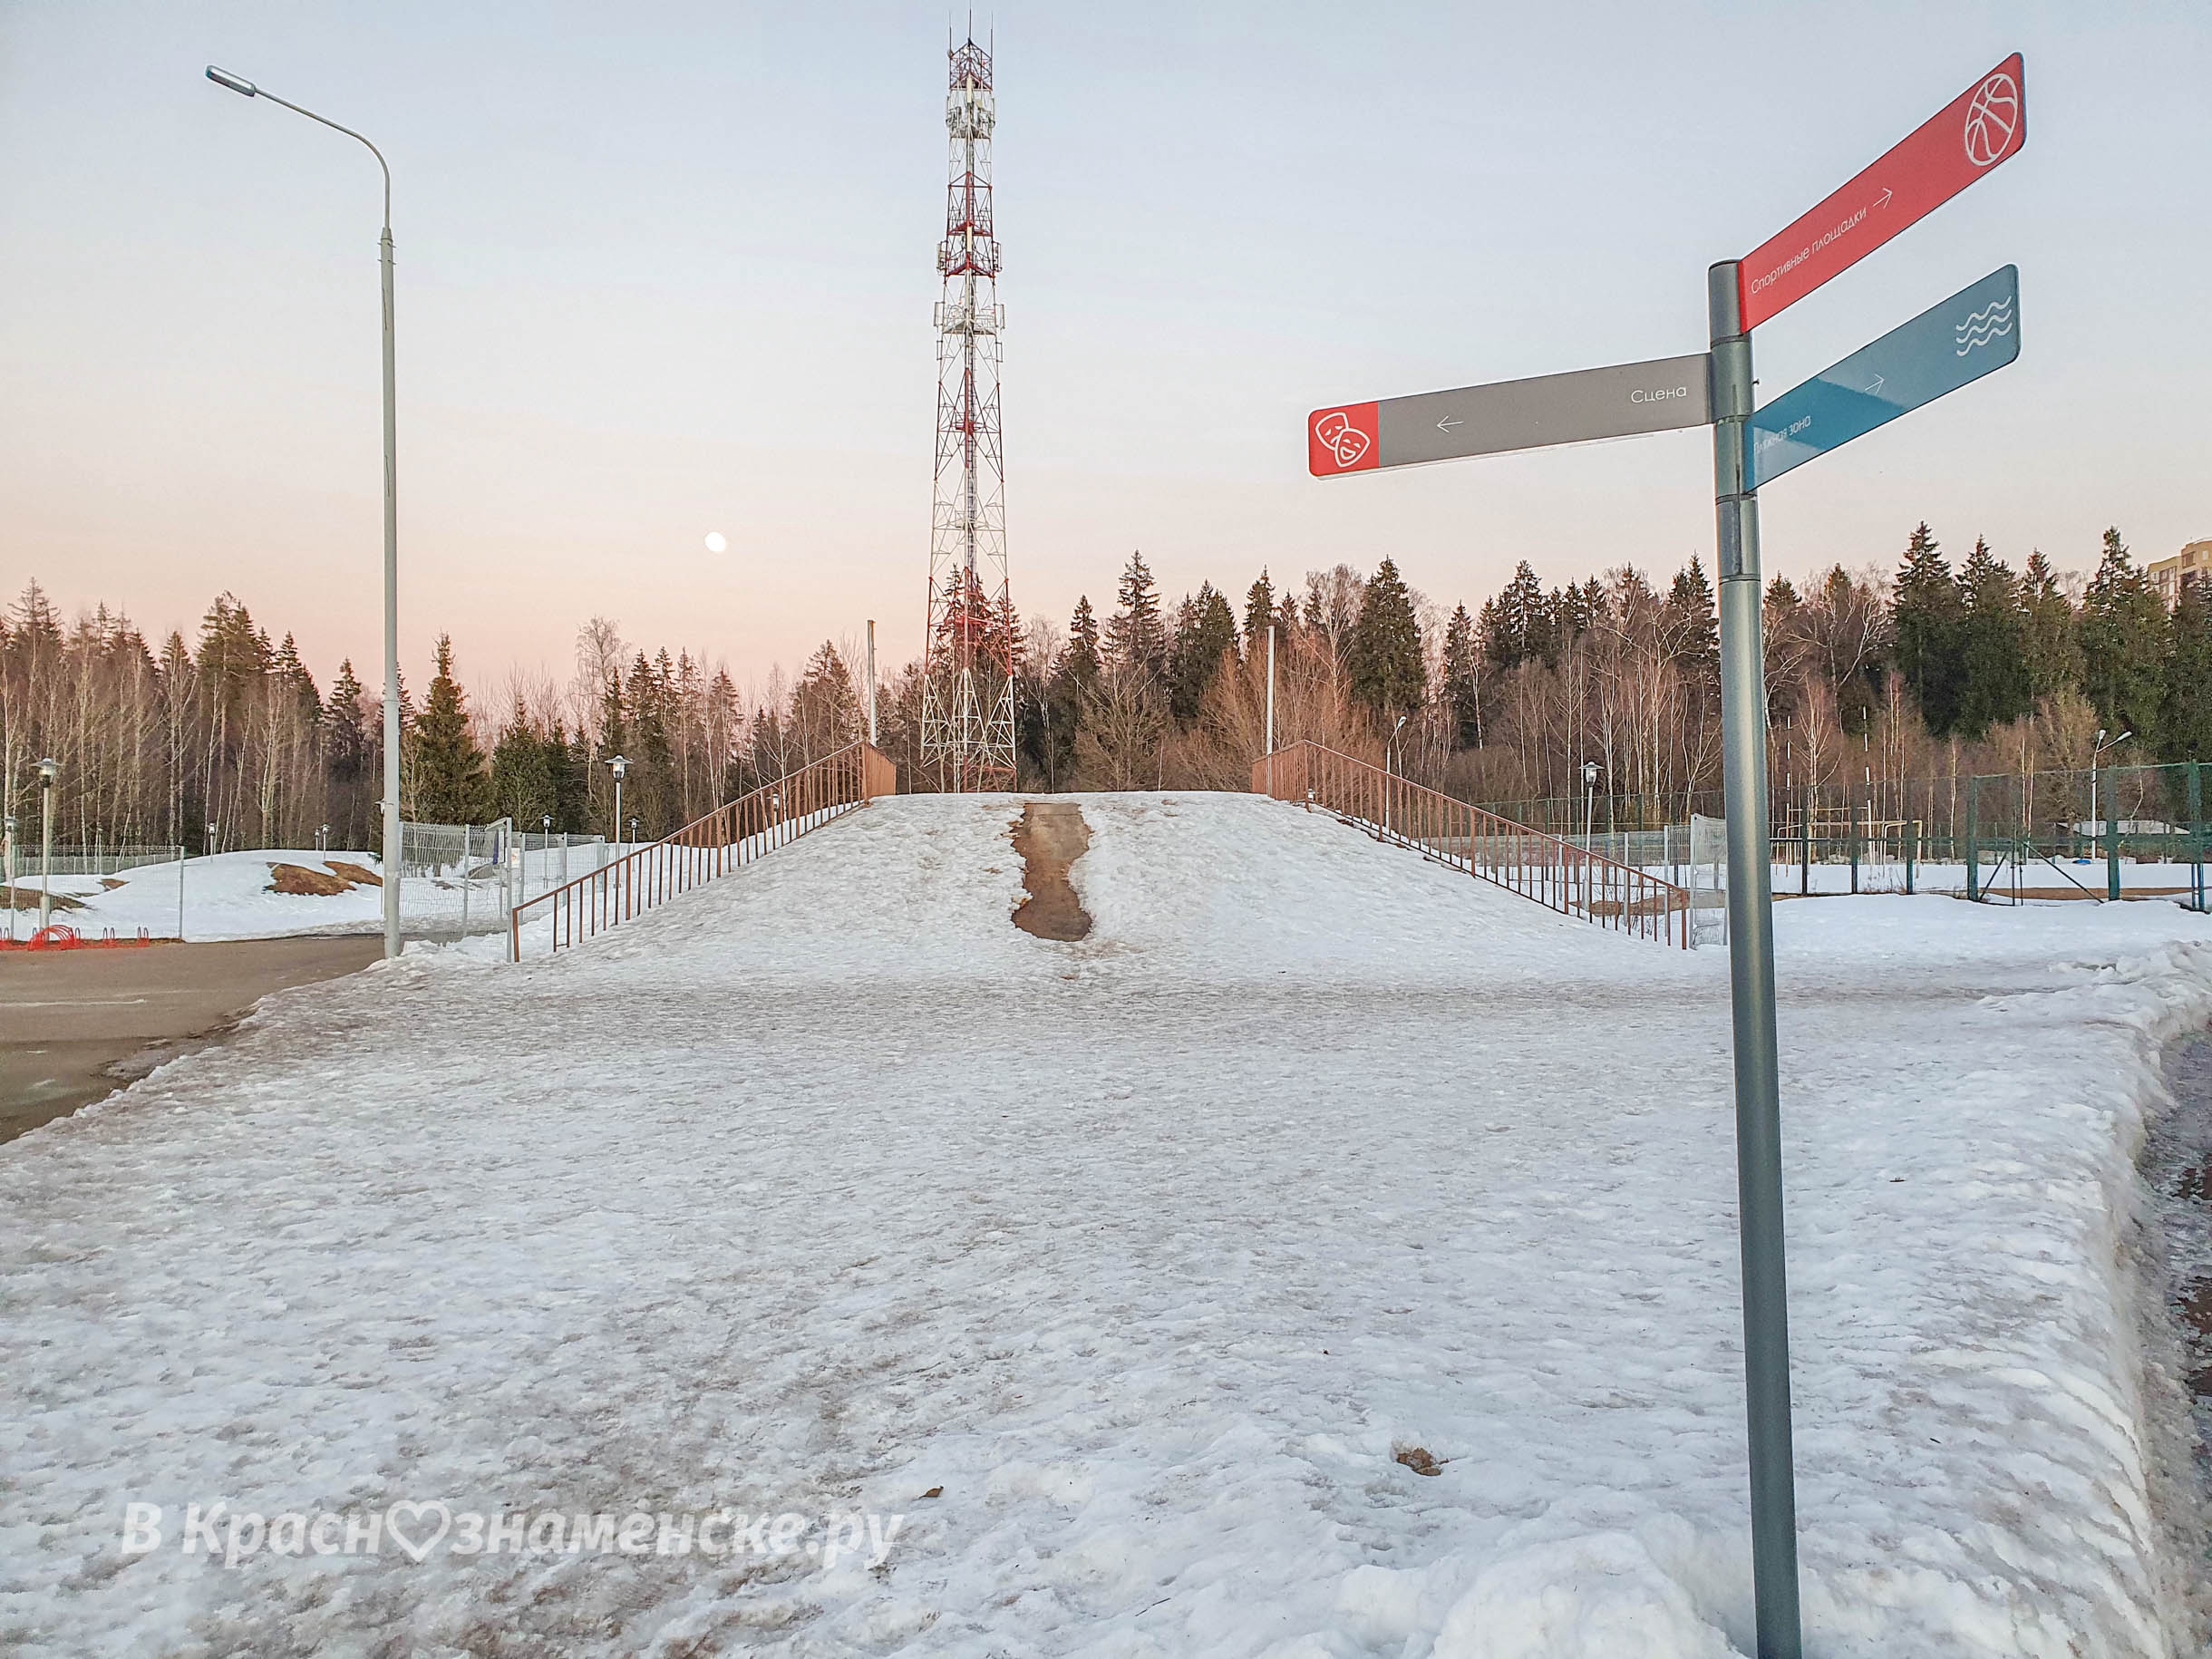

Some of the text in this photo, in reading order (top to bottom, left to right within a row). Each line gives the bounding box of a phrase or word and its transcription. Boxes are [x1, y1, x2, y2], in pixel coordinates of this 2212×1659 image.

[1751, 207, 1867, 294] Спортивные площадки
[1631, 386, 1687, 403] Сцена
[1789, 415, 1811, 436] зона
